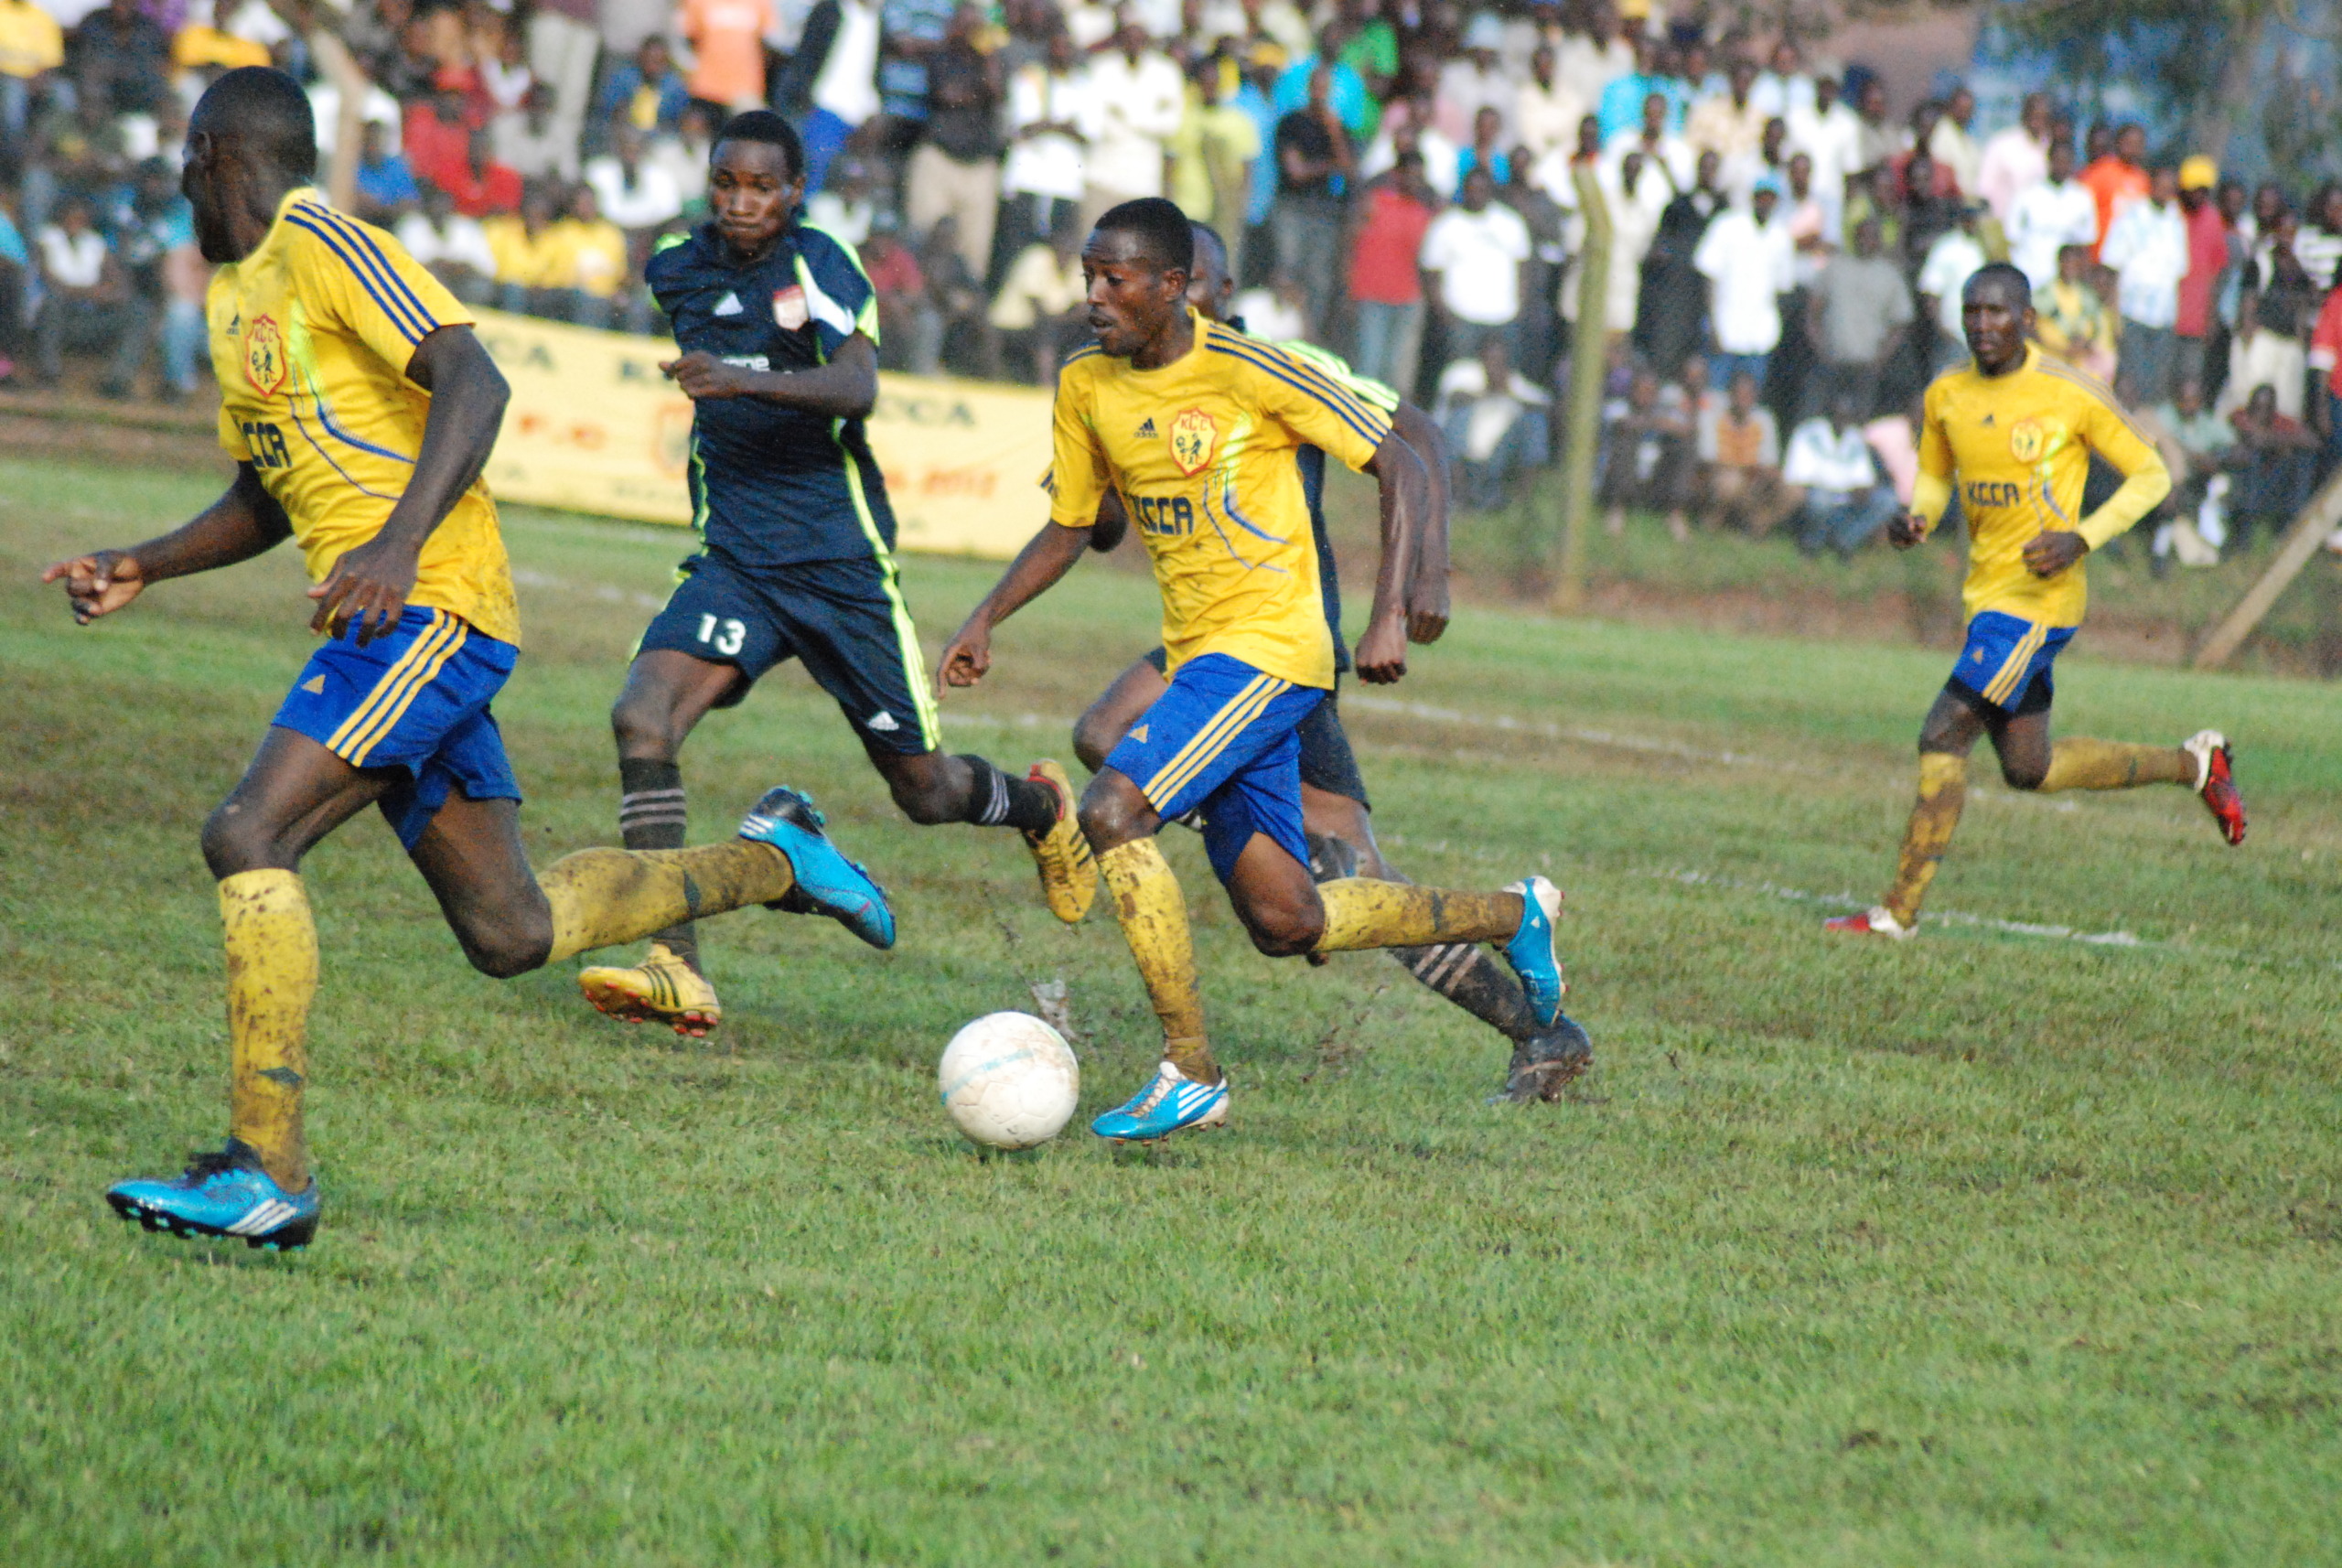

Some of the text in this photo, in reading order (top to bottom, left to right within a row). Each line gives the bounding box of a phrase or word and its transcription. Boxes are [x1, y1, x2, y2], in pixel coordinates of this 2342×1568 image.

[1181, 413, 1208, 431] KCC
[242, 422, 293, 468] CCA
[1966, 481, 2020, 508] KCCA
[697, 613, 747, 656] 13
